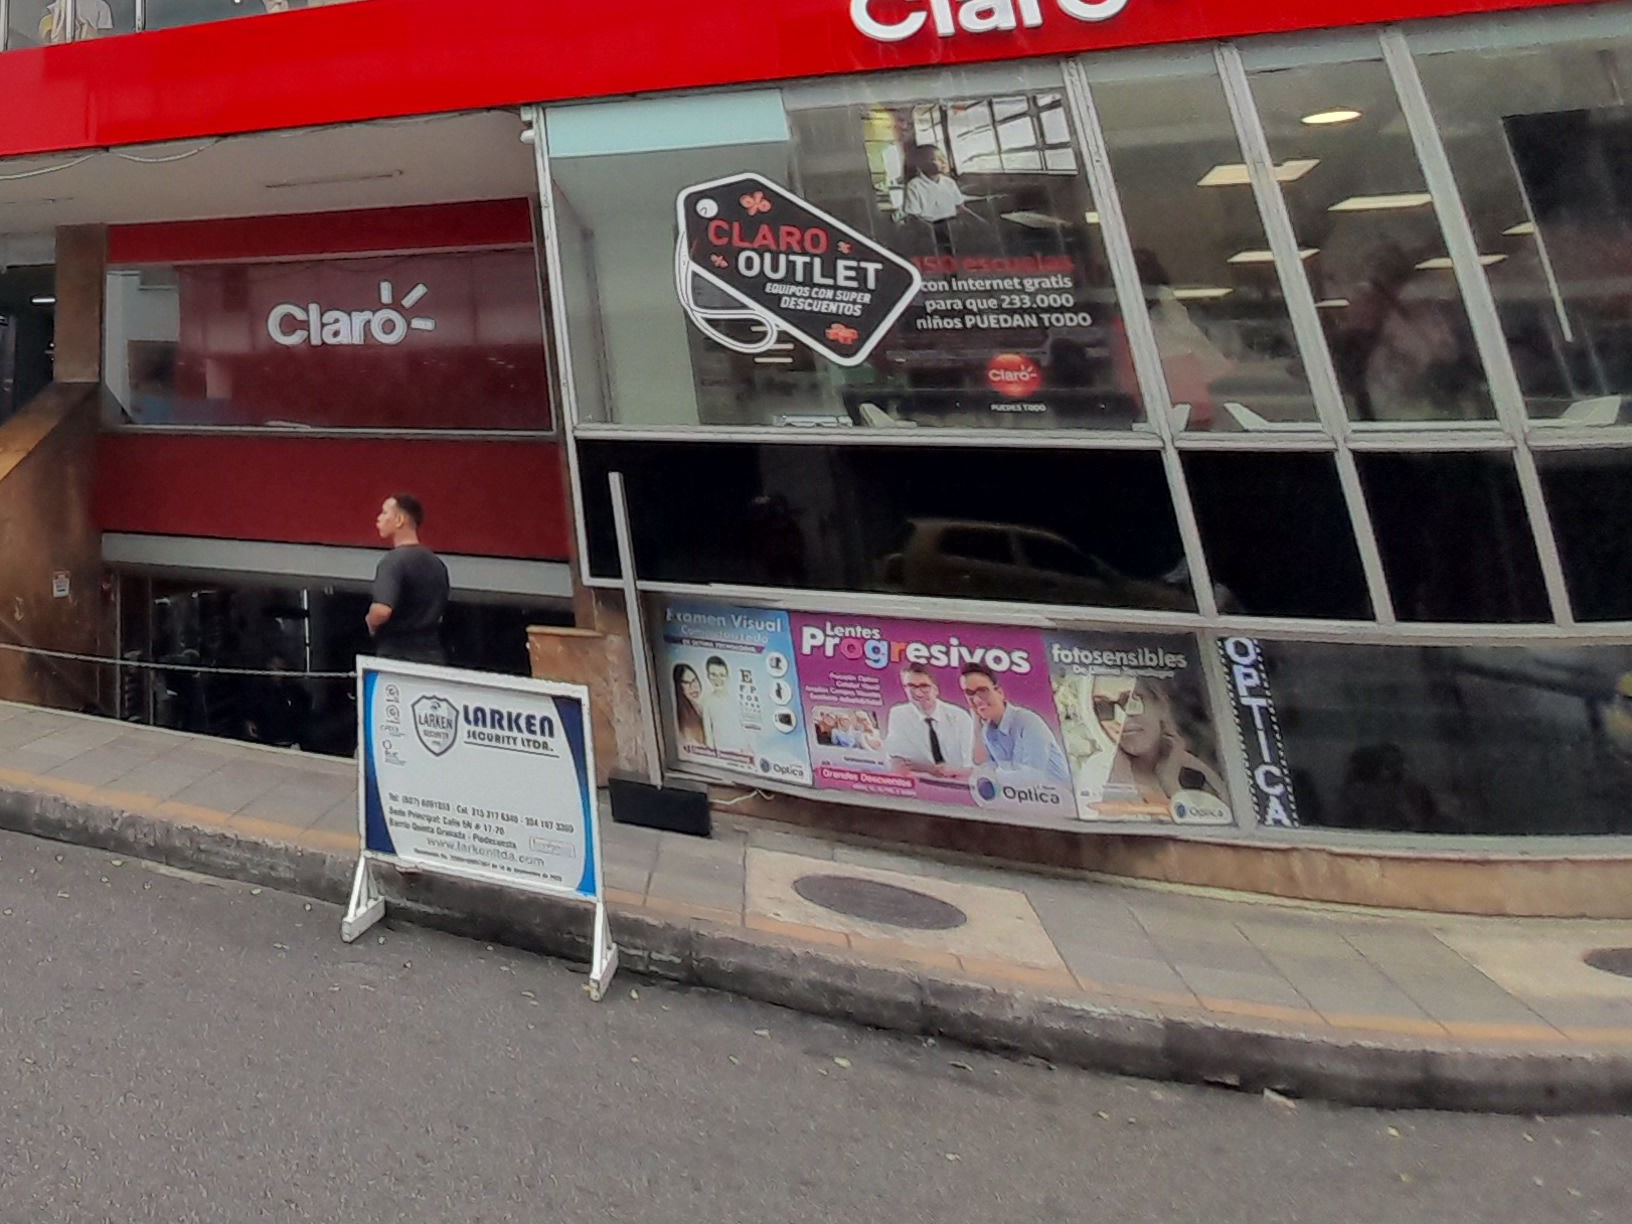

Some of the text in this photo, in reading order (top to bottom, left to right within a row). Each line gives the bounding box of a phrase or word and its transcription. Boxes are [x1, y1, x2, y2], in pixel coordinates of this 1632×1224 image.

[707, 219, 828, 255] CLARO
[737, 250, 883, 290] OUTLET
[765, 283, 872, 305] EQUIPOS CON SUPER
[920, 280, 949, 292] con
[1024, 275, 1073, 293] gratis
[780, 296, 863, 317] DESCUENTOS
[925, 294, 1074, 312] para que 233.000
[267, 302, 408, 346] Claro
[916, 312, 1093, 330] niños PUEDAN TODO
[988, 369, 1029, 381] Claro
[730, 613, 782, 633] Visual
[825, 621, 880, 640] Lentes
[801, 625, 1032, 675] Progresivos
[1051, 643, 1188, 669] fotosensibles
[418, 713, 454, 730] LARKEN
[463, 704, 556, 739] LARKEN
[1225, 637, 1291, 826] OPTICA
[467, 729, 519, 747] SECURITY
[773, 764, 805, 778] Optica
[1003, 787, 1060, 805] Optica
